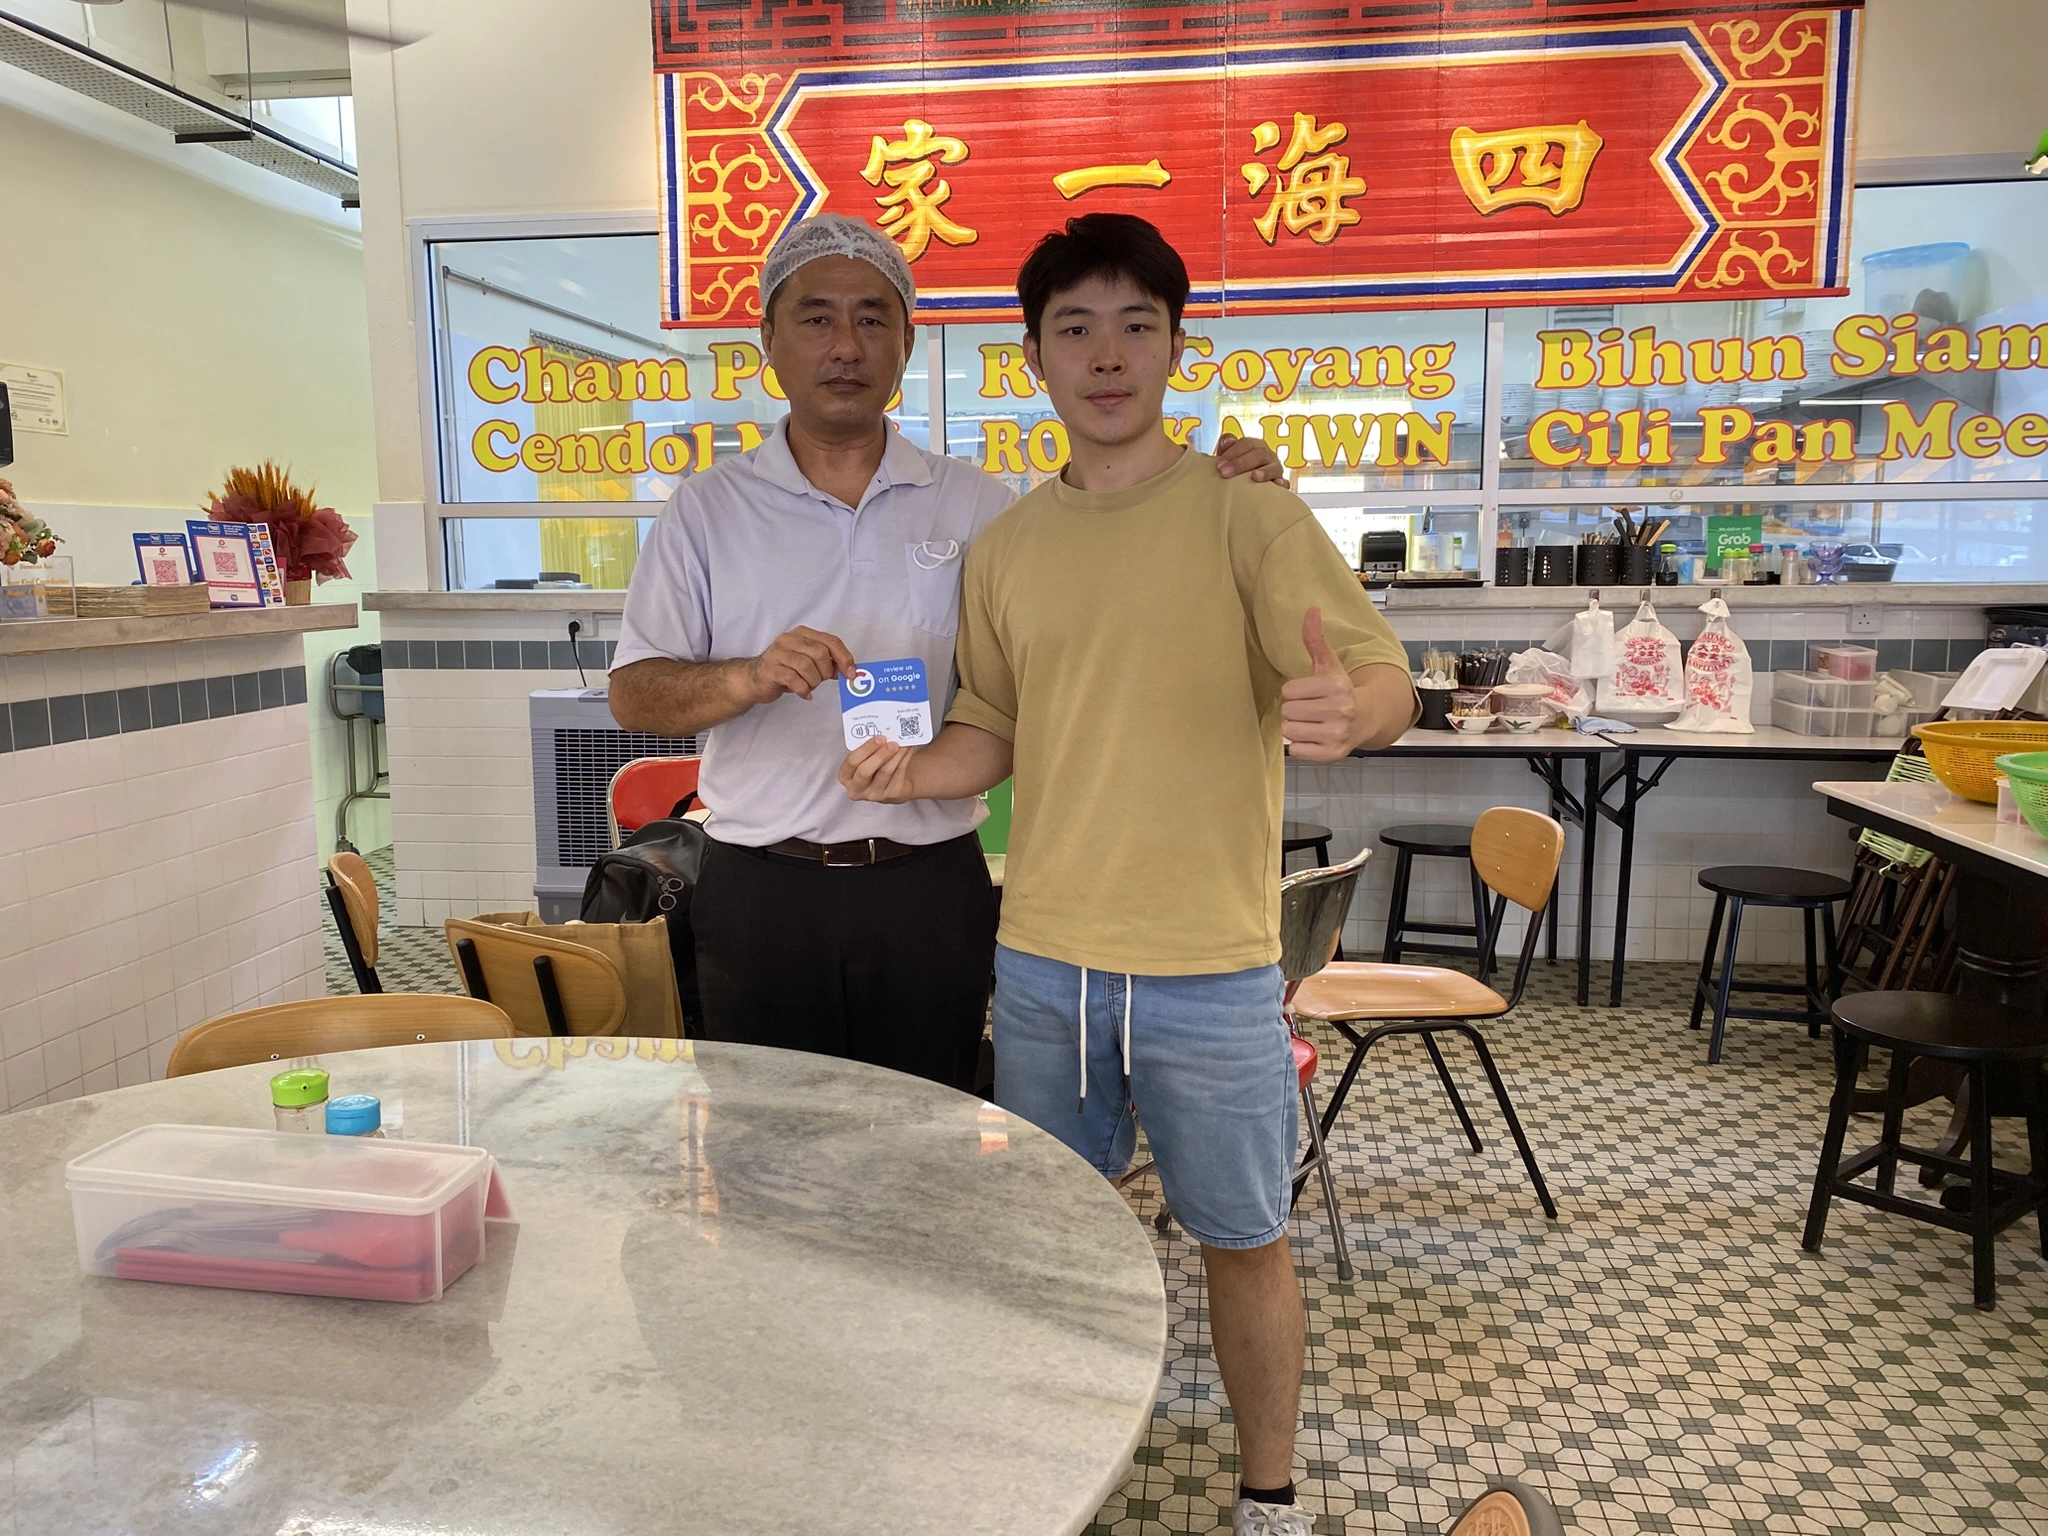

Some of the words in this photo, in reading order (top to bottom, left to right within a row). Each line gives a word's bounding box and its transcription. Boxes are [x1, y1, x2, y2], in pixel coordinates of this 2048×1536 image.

[468, 345, 691, 404] Cham
[1167, 336, 1456, 402] Goyang
[1535, 326, 1806, 388] Bihun
[1831, 313, 2048, 376] Siam
[471, 419, 713, 474] Cendol
[1528, 408, 1672, 467] Cili
[1698, 405, 1855, 463] Pan
[1879, 400, 2048, 460] Mee
[1718, 532, 1751, 545] Grab
[878, 676, 889, 684] on
[891, 673, 921, 683] Google
